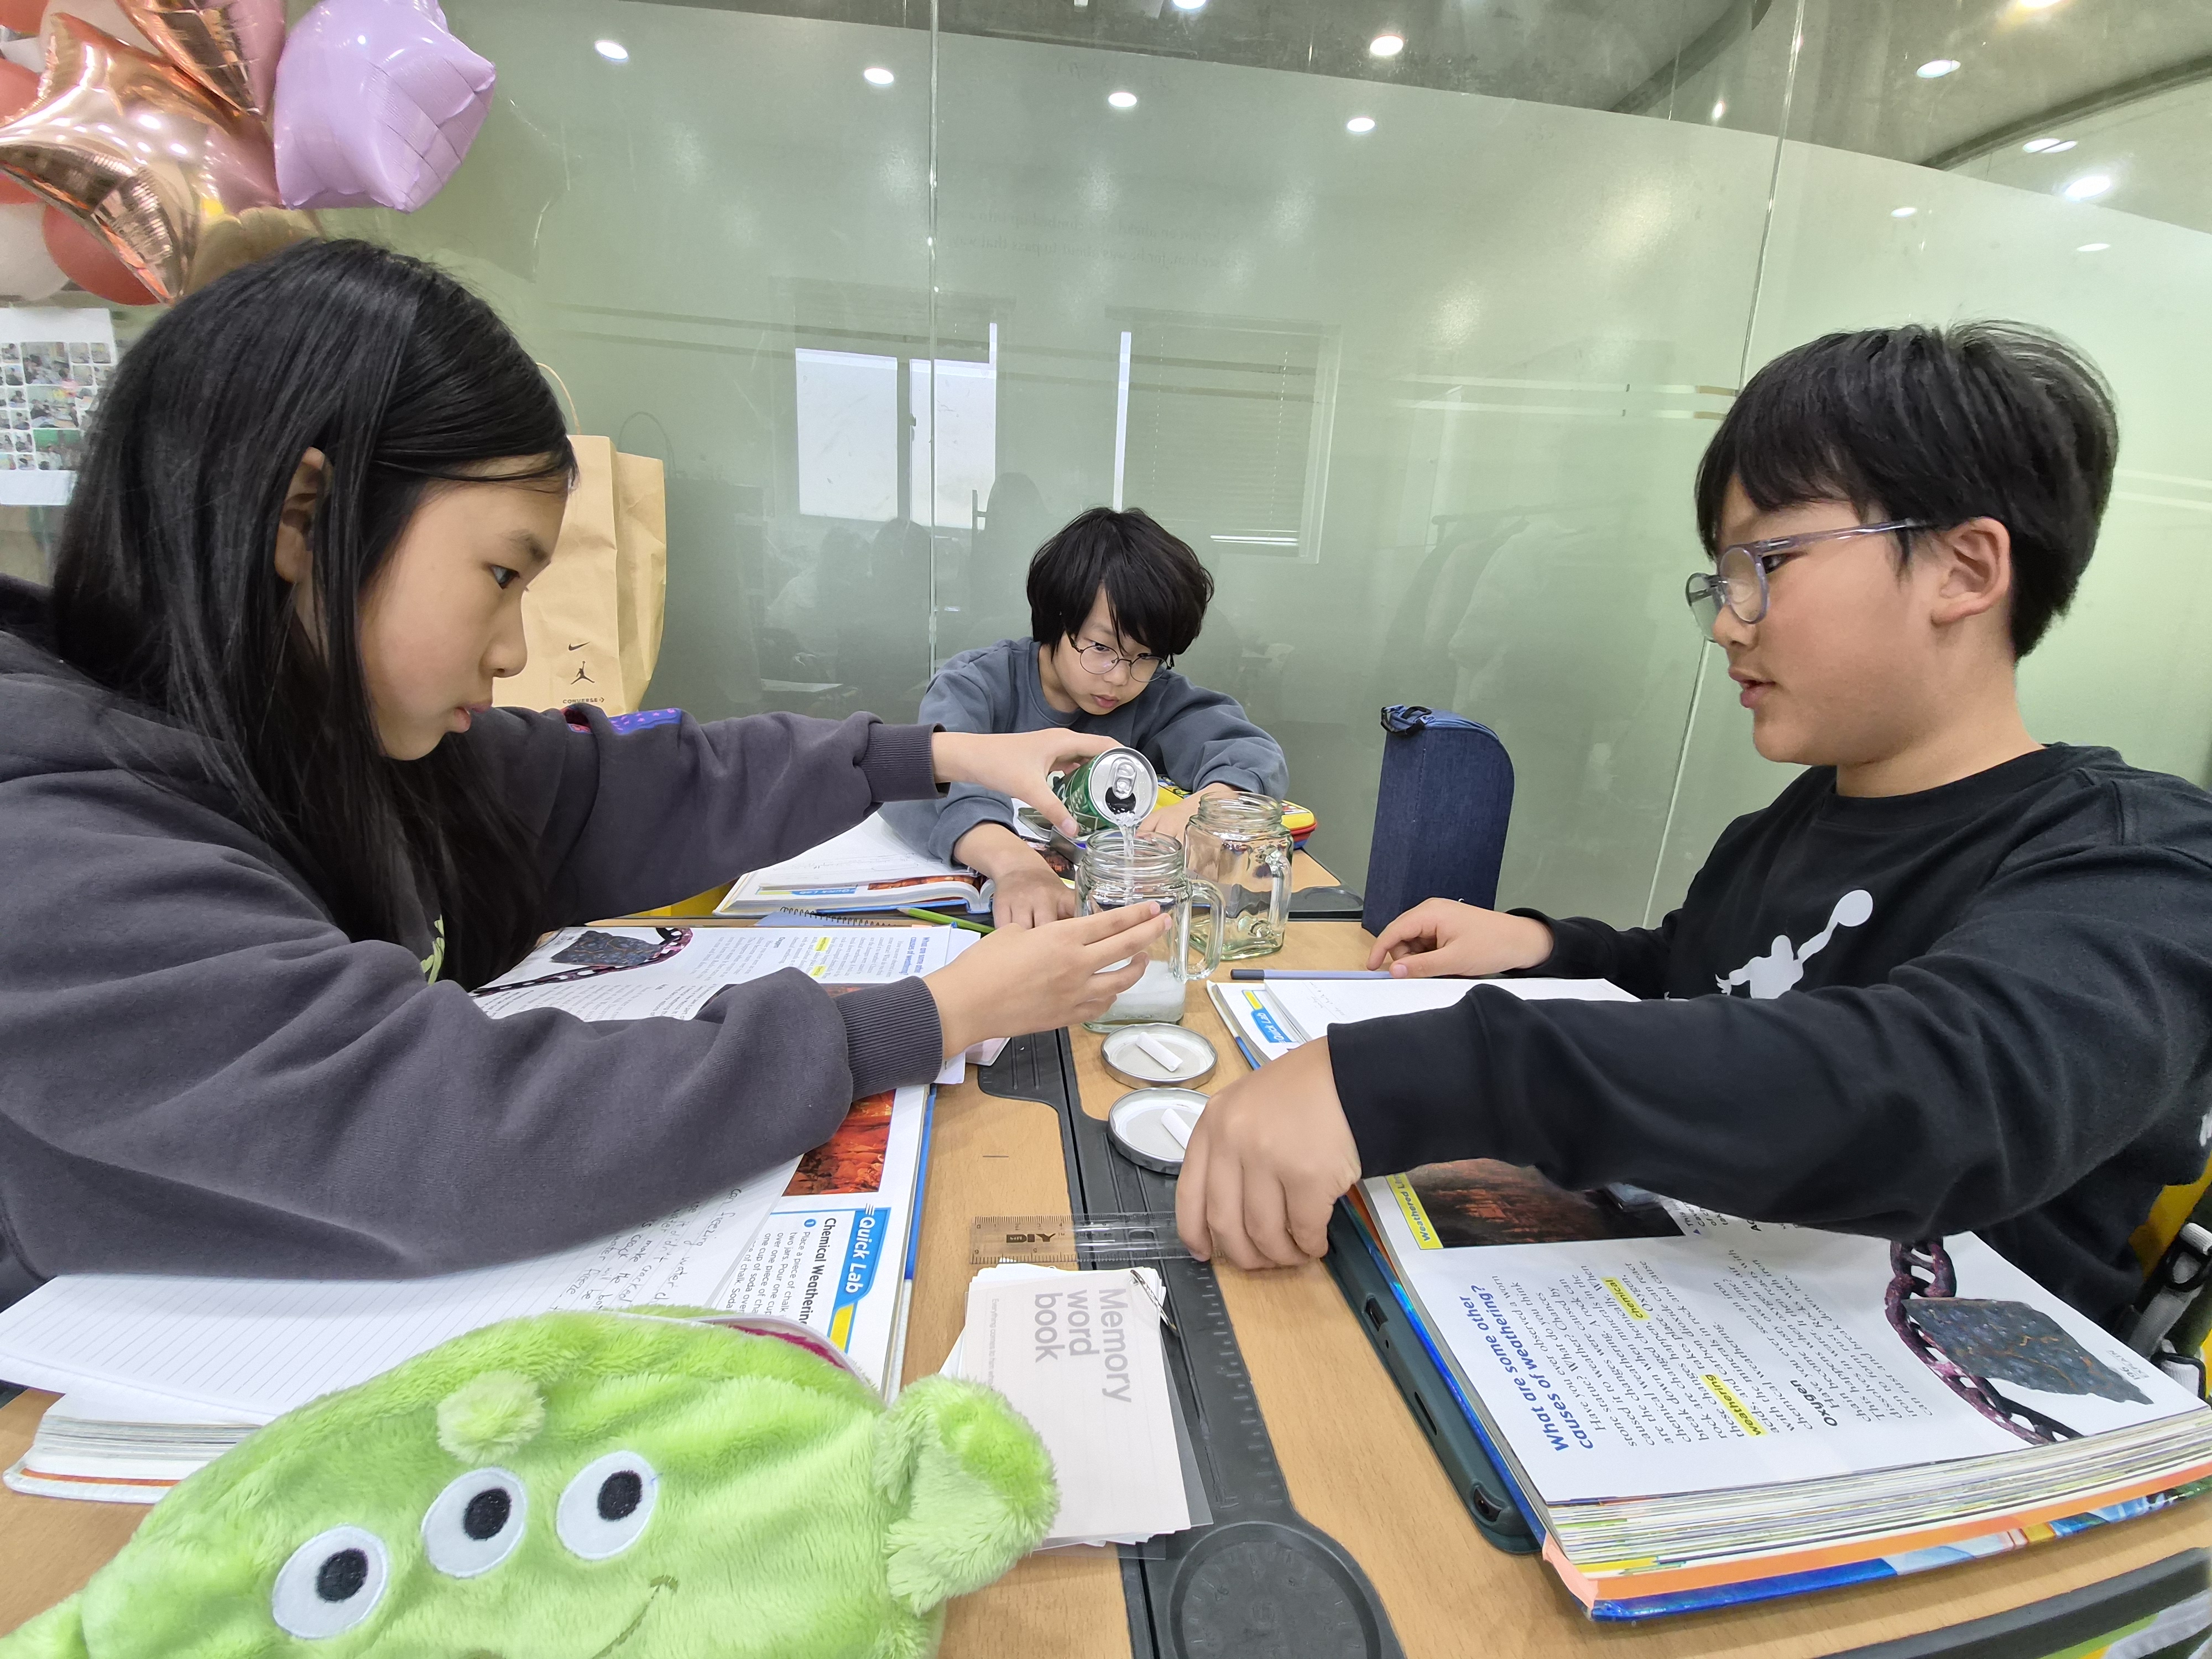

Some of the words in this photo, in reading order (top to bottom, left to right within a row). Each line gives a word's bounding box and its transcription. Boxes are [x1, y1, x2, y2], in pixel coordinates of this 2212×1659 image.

[1256, 1013, 1272, 1024] Lab
[1265, 1025, 1284, 1040] Quick
[1401, 1191, 1431, 1241] Weathered
[684, 1212, 735, 1247] freezing
[761, 1233, 771, 1246] one
[774, 1232, 783, 1248] over
[787, 1232, 797, 1245] two
[798, 1232, 810, 1250] Place
[814, 1218, 836, 1261] Chemical
[852, 1217, 876, 1259] Quick
[1006, 1233, 1056, 1243] DIY
[618, 1234, 641, 1259] crack
[630, 1240, 651, 1262] make
[653, 1229, 680, 1262] didn't
[756, 1248, 765, 1261] cup
[768, 1250, 778, 1263] one
[781, 1246, 793, 1261] jars.
[668, 1257, 690, 1288] water
[734, 1264, 748, 1285] chalk.
[760, 1265, 773, 1286] piece
[775, 1263, 788, 1281] Pour
[789, 1258, 801, 1279] piece
[844, 1263, 867, 1292] Lab
[1572, 1274, 1585, 1287] the
[1580, 1265, 1602, 1291] When
[1625, 1263, 1646, 1283] react
[1639, 1261, 1662, 1284] cause
[581, 1289, 602, 1300] be
[618, 1265, 651, 1302] cracked
[745, 1273, 757, 1292] soda
[757, 1288, 765, 1297] of
[770, 1284, 780, 1298] one
[786, 1280, 795, 1288] of
[1491, 1276, 1510, 1298] worn
[1510, 1282, 1533, 1305] think
[1547, 1286, 1560, 1297] by
[1559, 1279, 1574, 1294] can
[1584, 1291, 1595, 1299] in
[1622, 1275, 1653, 1311] Oxygen,
[1645, 1286, 1662, 1301] can
[1657, 1286, 1679, 1302] and
[726, 1288, 740, 1308] Soda
[739, 1294, 749, 1312] over
[751, 1299, 763, 1313] cha
[764, 1301, 774, 1315] cup
[779, 1291, 792, 1312] chalk
[1571, 1296, 1592, 1316] rock
[1605, 1280, 1643, 1318] chemical
[1067, 1289, 1100, 1356] word
[1459, 1296, 1489, 1331] other
[1531, 1309, 1550, 1325] you
[1536, 1292, 1567, 1331] Chances
[1554, 1300, 1585, 1331] caused
[1592, 1302, 1629, 1340] minerals
[1604, 1293, 1648, 1344] chemically.
[1661, 1304, 1694, 1337] dioxide
[1677, 1305, 1700, 1324] rock
[1035, 1292, 1066, 1364] book
[1470, 1285, 1537, 1370] weathering?
[1511, 1310, 1548, 1352] observed
[1545, 1328, 1558, 1340] do
[1656, 1314, 1683, 1340] place.
[1699, 1327, 1711, 1336] in
[1099, 1288, 1132, 1402] Memory
[1584, 1333, 1604, 1356] were
[1646, 1322, 1679, 1360] happen,
[1712, 1322, 1764, 1378] weathering.
[1485, 1335, 1518, 1373] some
[1546, 1355, 1565, 1375] ever
[1556, 1343, 1578, 1372] What
[1564, 1334, 1603, 1378] weather?
[1601, 1331, 1647, 1389] weathering.
[1627, 1344, 1651, 1370] when
[1679, 1343, 1705, 1369] takes
[1693, 1340, 1727, 1375] carbon
[1709, 1339, 1752, 1382] minerals
[1528, 1373, 1551, 1388] of
[1603, 1359, 1640, 1401] changes
[1643, 1347, 1685, 1389] changed
[1514, 1378, 1536, 1401] are
[1563, 1379, 1585, 1397] you
[1576, 1375, 1611, 1412] statue?
[1602, 1381, 1614, 1392] to
[1651, 1374, 1679, 1404] down
[1678, 1363, 1717, 1405] changes
[1723, 1378, 1747, 1397] and
[1751, 1386, 1770, 1402] the
[1684, 1392, 1702, 1409] are
[1704, 1374, 1761, 1435] weathering
[1761, 1381, 1813, 1430] chemical
[1790, 1380, 1838, 1426] Oxygen
[1547, 1393, 1593, 1449] causes
[1580, 1401, 1606, 1430] Have
[1638, 1405, 1656, 1422] the
[1643, 1392, 1691, 1442] chemical
[1677, 1408, 1709, 1440] break
[1700, 1413, 1728, 1438] rock
[1716, 1408, 1744, 1437] these
[1750, 1401, 1779, 1433] acids,
[1768, 1406, 1794, 1431] with
[1530, 1406, 1569, 1451] What
[1609, 1416, 1637, 1446] stone
[1617, 1407, 1655, 1446] caused
[1655, 1426, 1673, 1443] are
